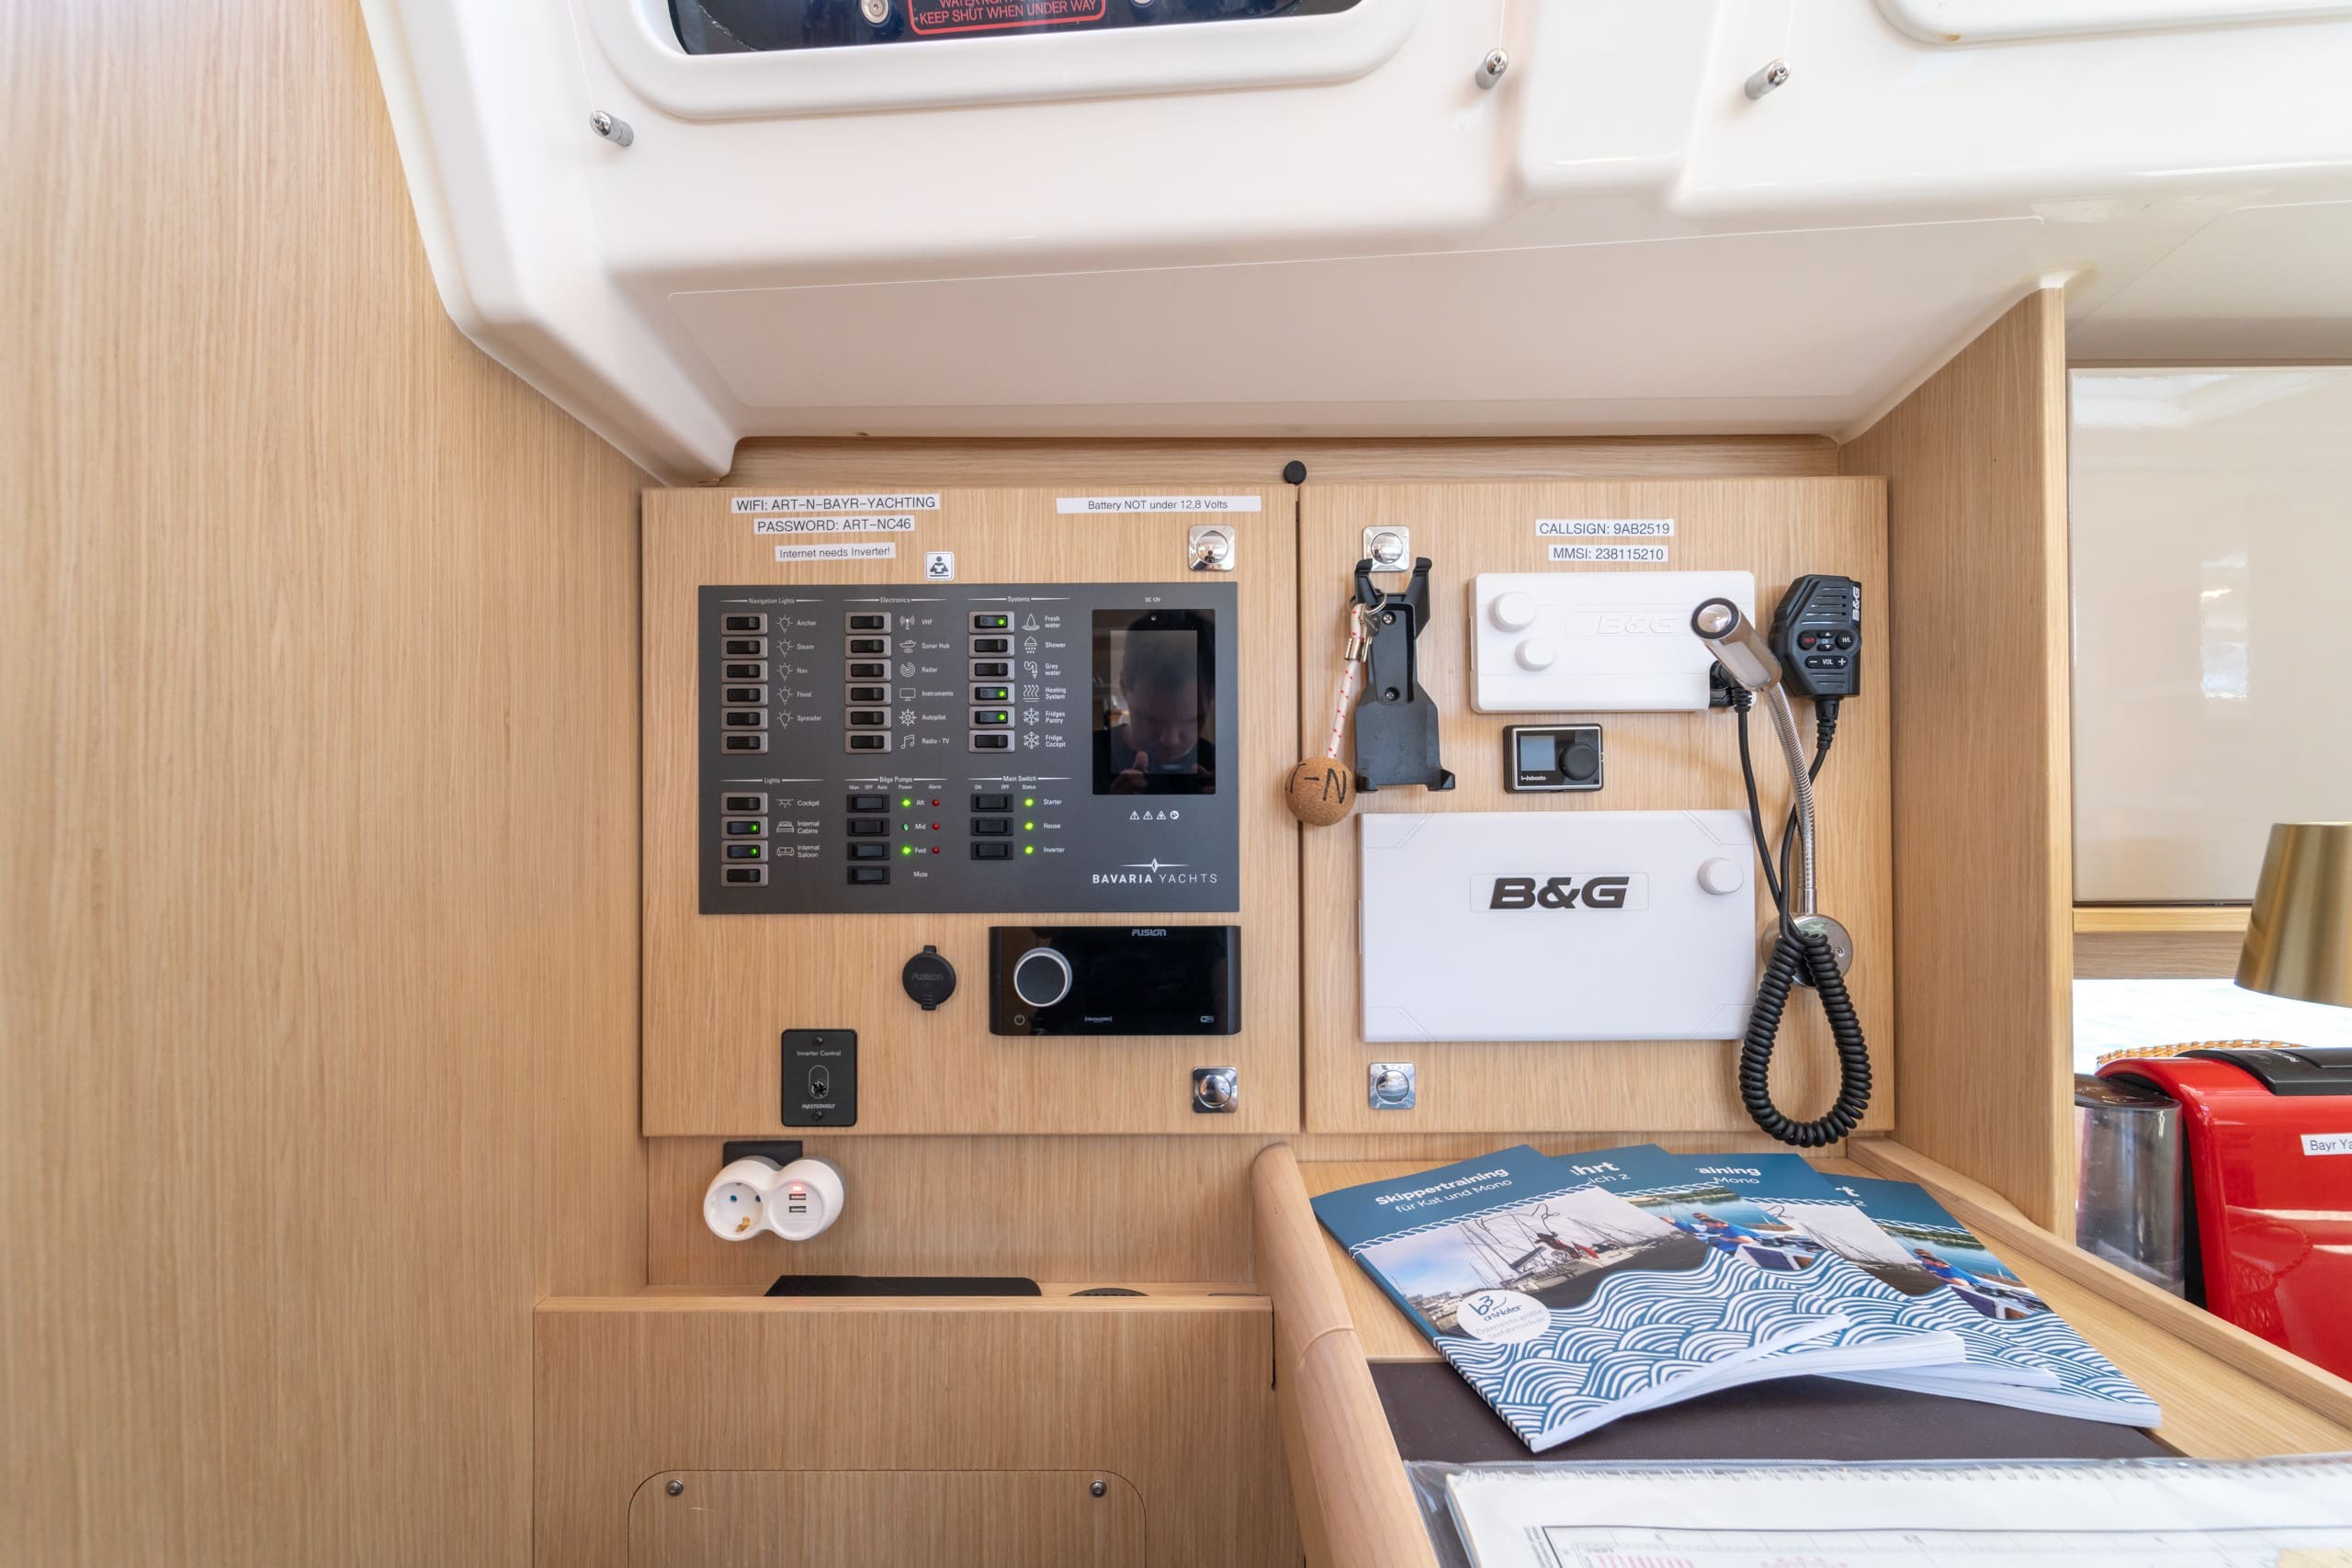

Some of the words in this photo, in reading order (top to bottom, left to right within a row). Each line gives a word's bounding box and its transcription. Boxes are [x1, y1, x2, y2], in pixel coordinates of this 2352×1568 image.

[920, 11, 949, 25] KEEP
[952, 7, 983, 23] SHUT
[987, 6, 1023, 19] WHEN
[1026, 2, 1068, 16] UNDER
[1070, 0, 1096, 12] WAY
[736, 500, 769, 512] WIFI:
[772, 497, 935, 511] ART-N-BAYR-YACHTING
[1088, 501, 1121, 511] Battery
[1124, 500, 1147, 510] NOT
[1149, 500, 1177, 510] under
[1181, 500, 1202, 511] 12,8
[1204, 500, 1228, 509] Volts
[757, 520, 839, 533] PASSWORD:
[842, 518, 911, 531] ART-NC46
[1539, 523, 1610, 535] CALLSIGN:
[1613, 523, 1670, 535] 9AB2519
[779, 549, 817, 558] Internet
[819, 548, 848, 558] needs
[851, 547, 890, 557] Inverter!
[1554, 547, 1591, 559] MMSI:
[1595, 548, 1664, 560] 238115210
[1597, 615, 1677, 635] B&G
[1092, 874, 1153, 884] BAVARIA
[1159, 874, 1218, 884] YACHTS
[1489, 876, 1631, 909] B&G
[1131, 929, 1167, 937] FUSION
[2310, 1139, 2336, 1152] Bayr
[1695, 1167, 1762, 1176] aining
[1374, 1168, 1510, 1205] Skippertraining
[1713, 1176, 1760, 1185] Mono
[1395, 1203, 1416, 1213] für
[1419, 1196, 1445, 1208] Kat
[1444, 1190, 1472, 1201] und
[1474, 1179, 1512, 1193] Mono
